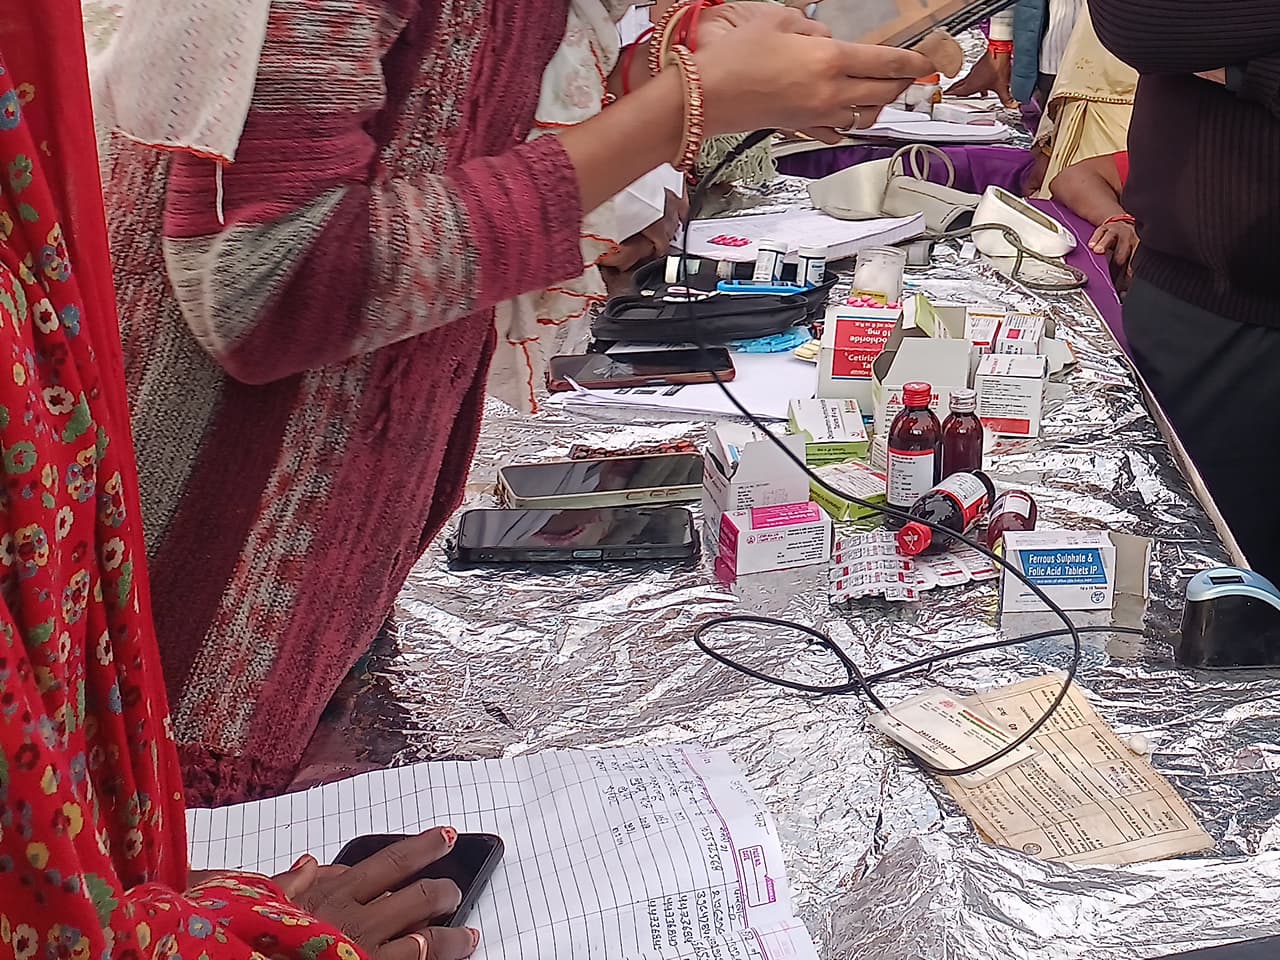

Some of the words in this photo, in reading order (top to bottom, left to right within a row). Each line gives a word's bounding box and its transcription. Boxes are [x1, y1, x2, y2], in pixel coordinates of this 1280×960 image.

[849, 335, 888, 344] ochloride
[848, 353, 877, 361] Cetirizi
[1029, 553, 1055, 564] Ferrous
[1087, 553, 1094, 562] &
[1028, 566, 1045, 576] Folic
[1046, 566, 1062, 576] Acid
[1064, 566, 1089, 575] Tablets
